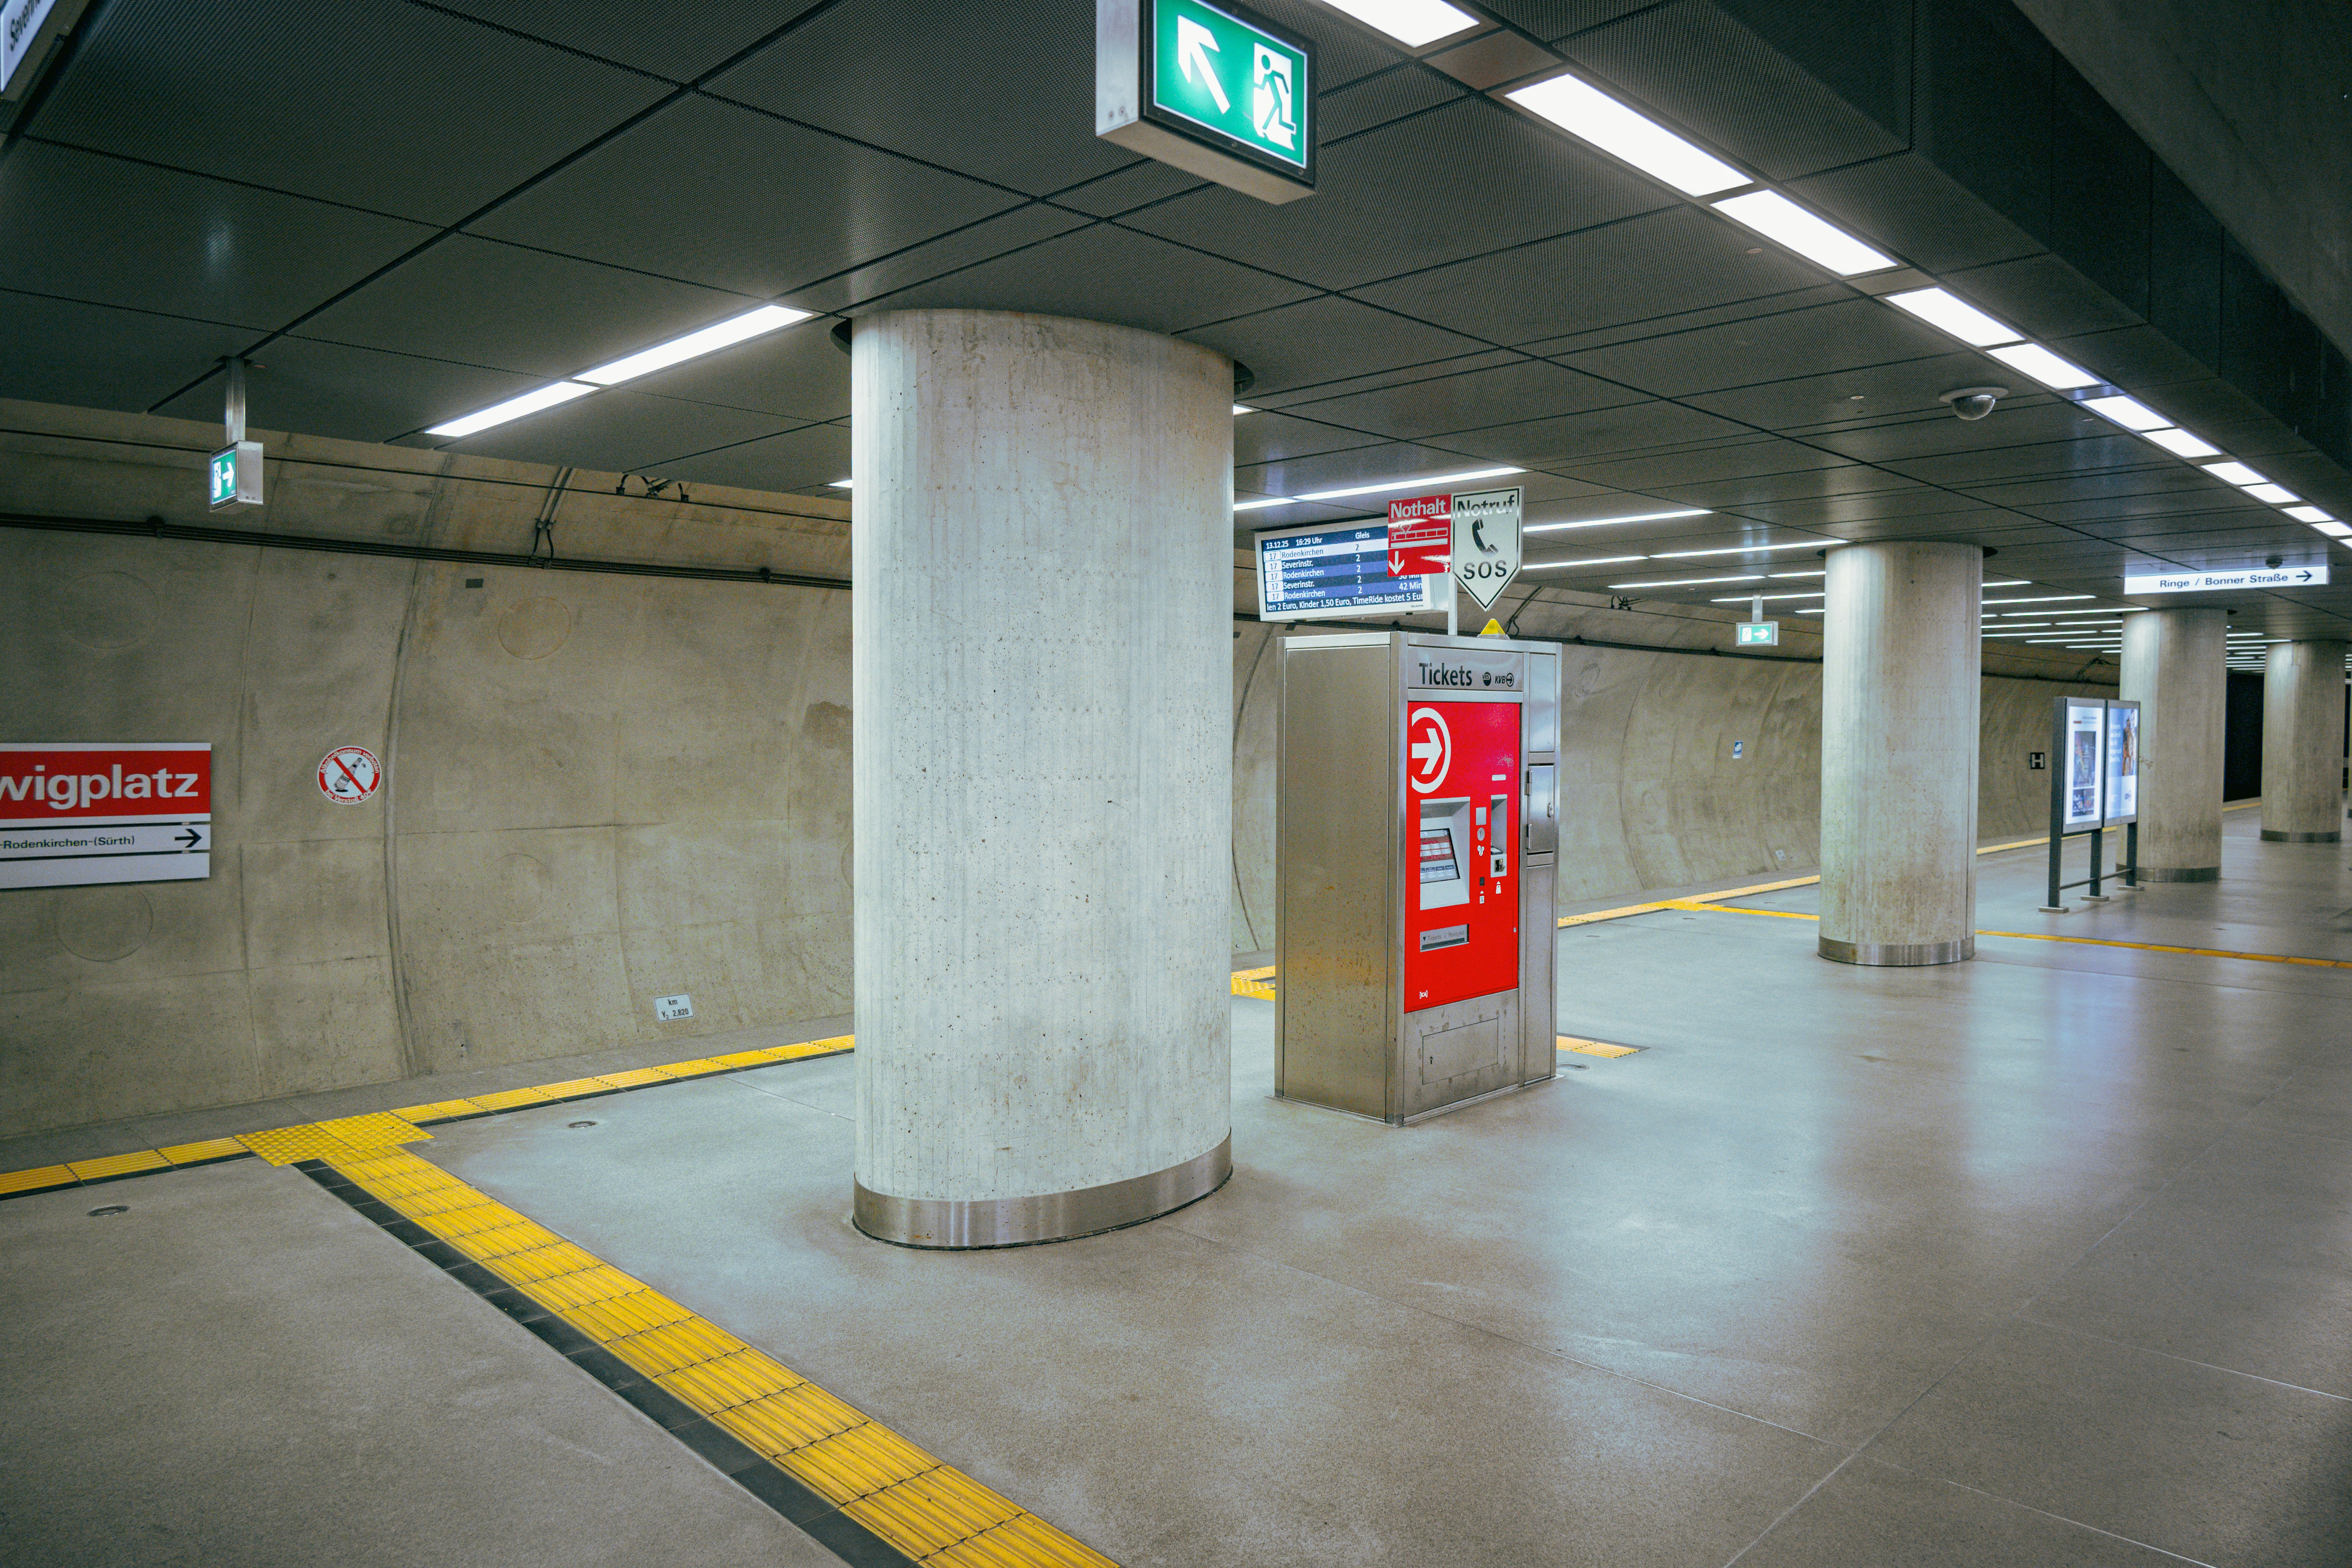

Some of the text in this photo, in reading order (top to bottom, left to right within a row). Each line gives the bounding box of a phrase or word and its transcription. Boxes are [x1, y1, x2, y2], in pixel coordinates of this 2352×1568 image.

[1391, 498, 1446, 518] Nothalt
[1457, 495, 1514, 518] Notruf
[1266, 540, 1289, 549] 13.12.25
[1296, 538, 1311, 546] 16:29
[1282, 549, 1323, 558] Rodenkirchen
[1282, 560, 1313, 569] Severinstr.
[1464, 560, 1507, 579] SOS
[1283, 569, 1324, 579] Rodenkirchen
[2160, 574, 2288, 588] Ringe / Bonner Straße
[1283, 581, 1314, 589] Severinstr.
[1284, 590, 1325, 600] Rodenkirchen
[1399, 582, 1408, 590] 42
[1409, 581, 1422, 590] Min
[1299, 600, 1319, 609] Kinder
[1320, 599, 1334, 608] 1,50
[1353, 595, 1383, 605] TimeRide
[1384, 593, 1405, 602] kostet
[1419, 663, 1472, 686] Tickets
[1495, 676, 1506, 684] KVB
[320, 749, 379, 774] Alkoholkonsum verboten
[325, 789, 373, 803] bei Verstoß 40€
